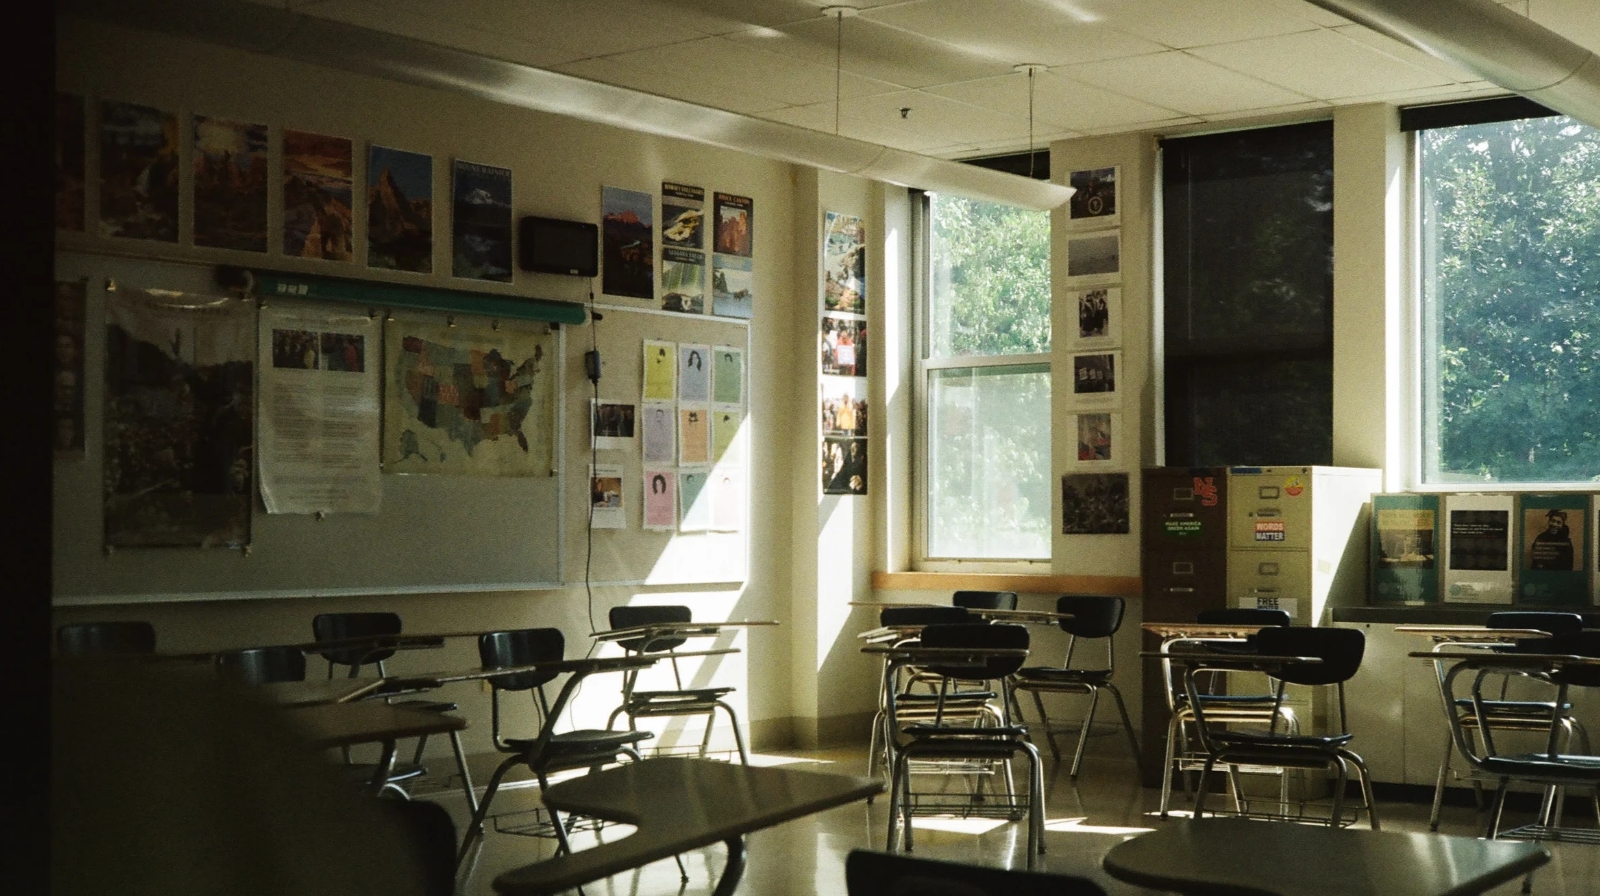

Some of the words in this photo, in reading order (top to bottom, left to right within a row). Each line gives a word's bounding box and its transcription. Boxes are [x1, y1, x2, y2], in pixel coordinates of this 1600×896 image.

[1256, 522, 1284, 531] WORDS
[1256, 532, 1284, 541] MATTER
[1257, 597, 1279, 606] FREE
